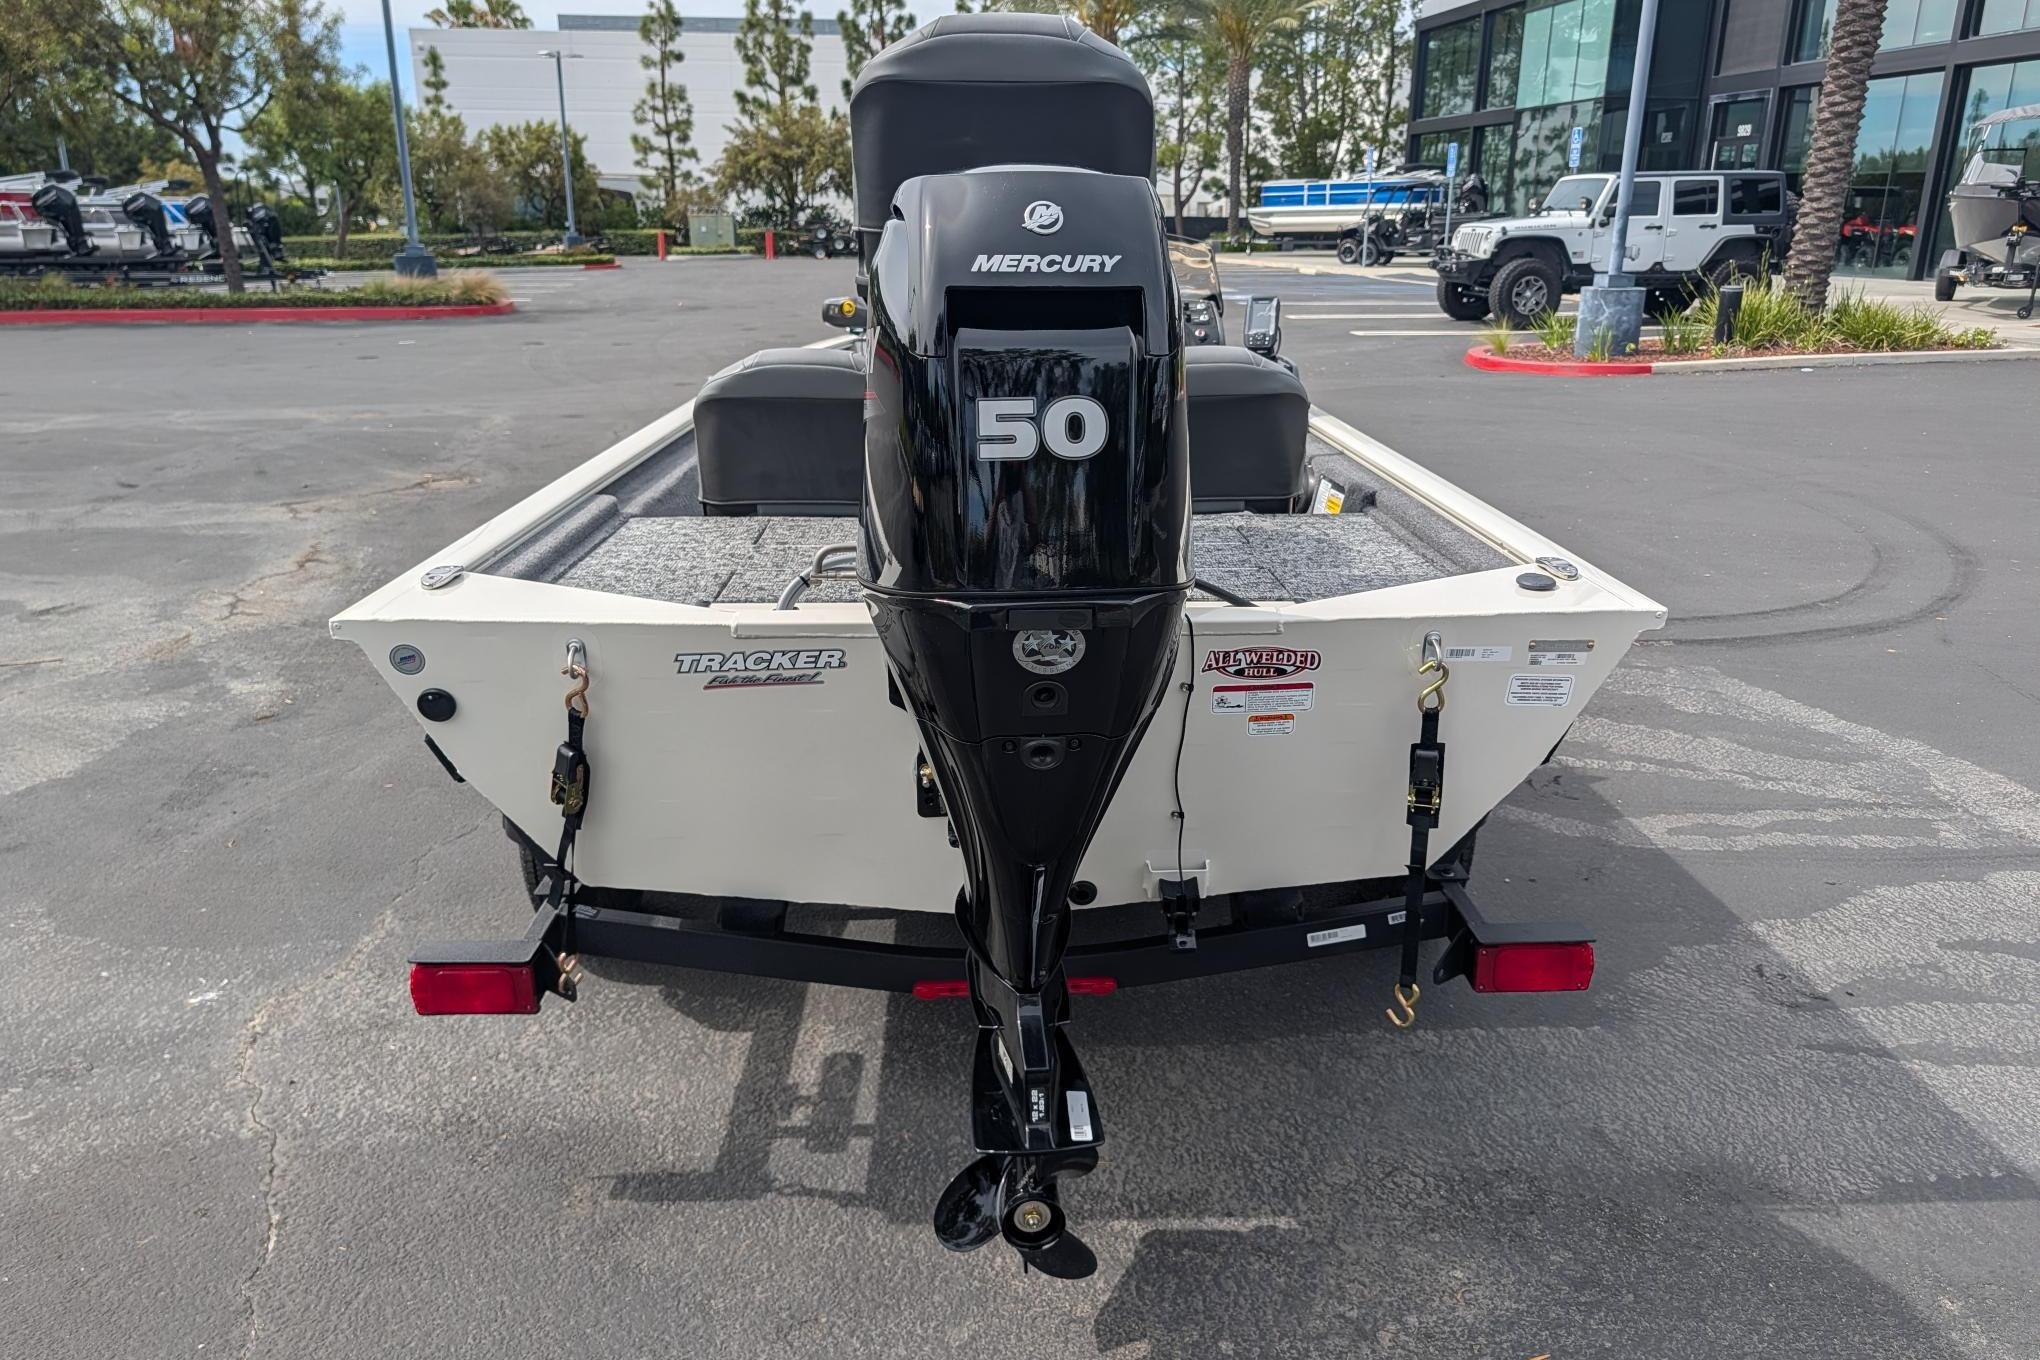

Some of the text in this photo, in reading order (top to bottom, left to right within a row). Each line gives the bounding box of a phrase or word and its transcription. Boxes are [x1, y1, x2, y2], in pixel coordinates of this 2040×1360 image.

[970, 254, 1122, 273] MERCURY
[975, 395, 1109, 461] 50
[673, 649, 846, 674] TRACKER
[1201, 649, 1321, 673] ALL WELDED
[708, 674, 738, 685] Fish
[740, 673, 762, 684] the
[1244, 667, 1278, 677] HULL
